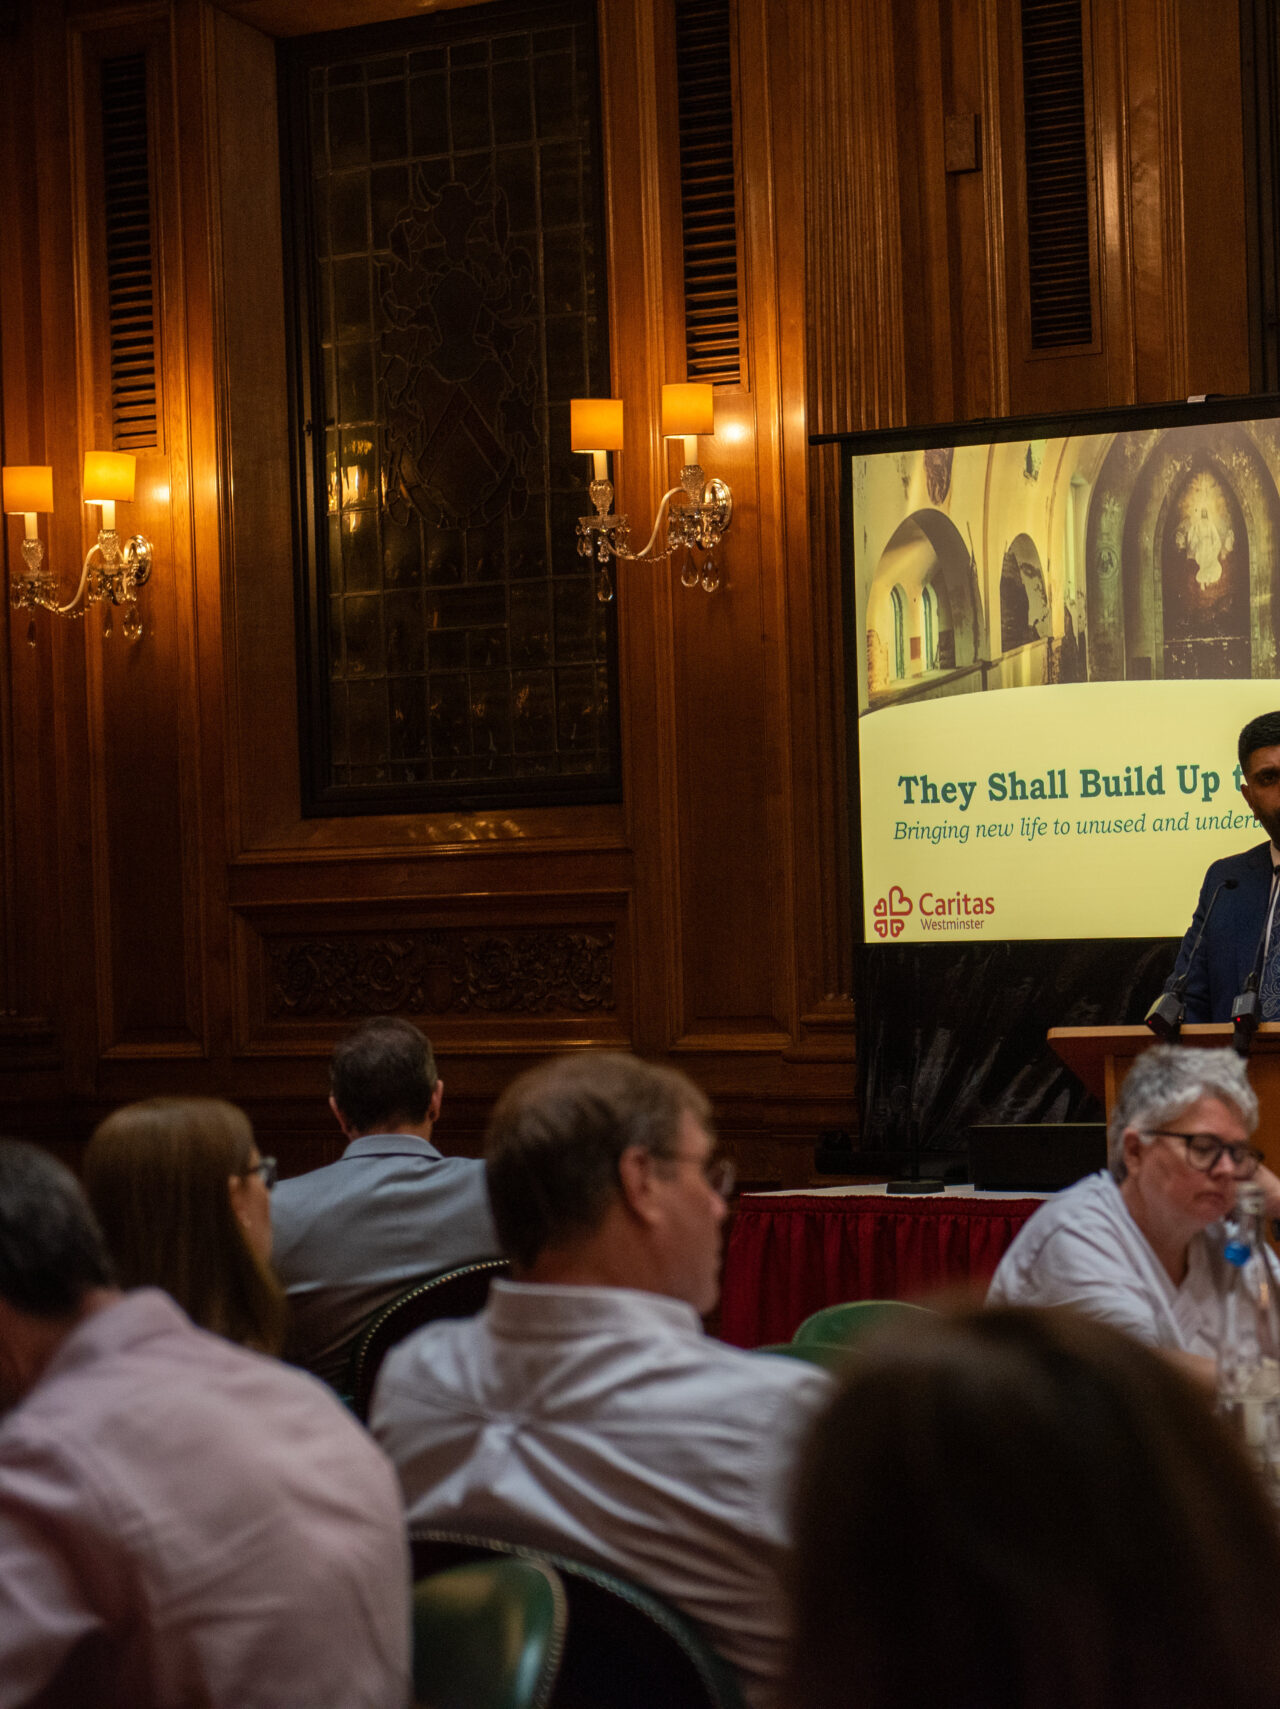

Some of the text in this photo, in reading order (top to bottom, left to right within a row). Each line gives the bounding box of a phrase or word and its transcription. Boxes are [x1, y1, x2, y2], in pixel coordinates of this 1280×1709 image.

[898, 775, 977, 812] They
[988, 769, 1068, 802] Shall
[1079, 765, 1166, 798] Build
[1176, 764, 1221, 802] Up
[893, 819, 970, 845] Bringing
[976, 823, 1013, 839] new
[1020, 816, 1048, 842] life
[1053, 818, 1071, 836] to
[1076, 813, 1146, 834] unused
[1152, 811, 1190, 832] and
[918, 891, 995, 917] Caritas
[920, 917, 985, 931] Westminster
